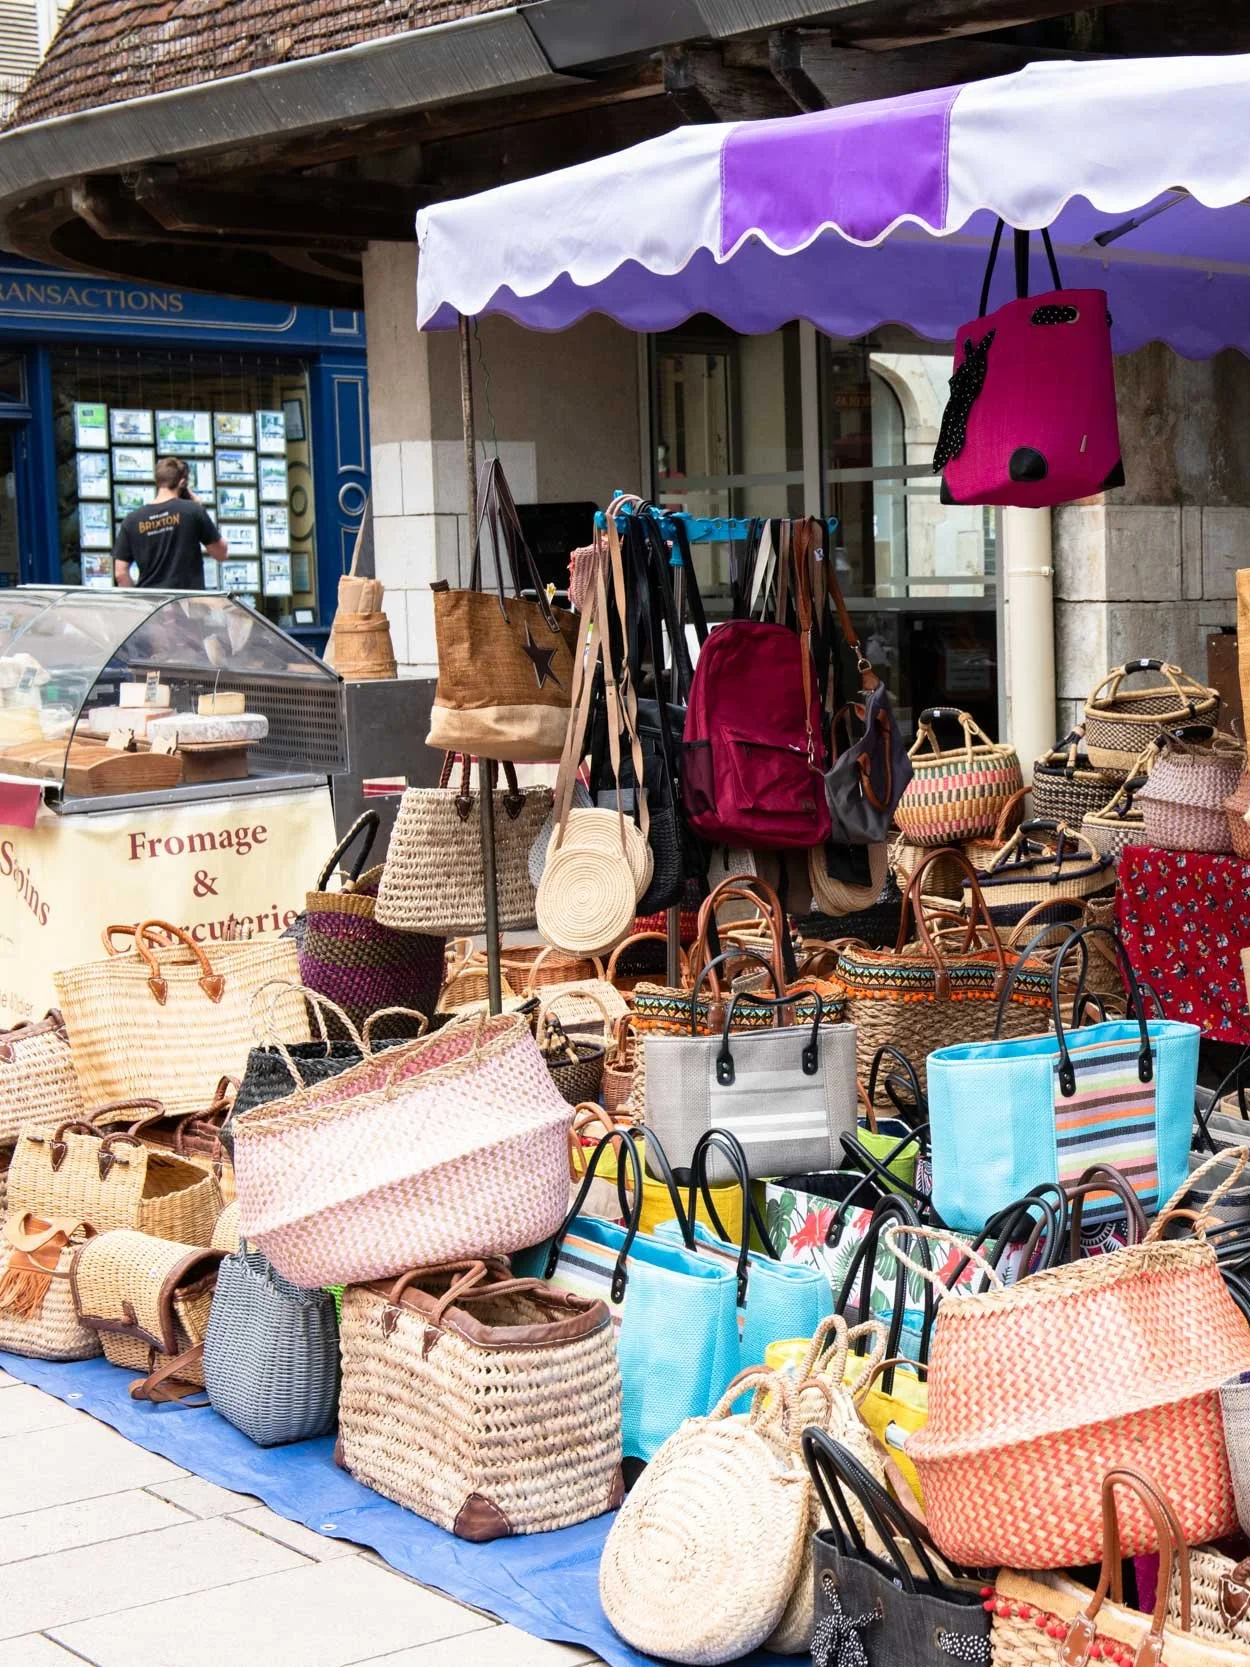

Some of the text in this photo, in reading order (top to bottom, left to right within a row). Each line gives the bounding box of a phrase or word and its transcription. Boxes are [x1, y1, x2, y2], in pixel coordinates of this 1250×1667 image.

[138, 511, 181, 535] BRIXTON
[127, 824, 268, 861] Fromage
[193, 869, 219, 898] &
